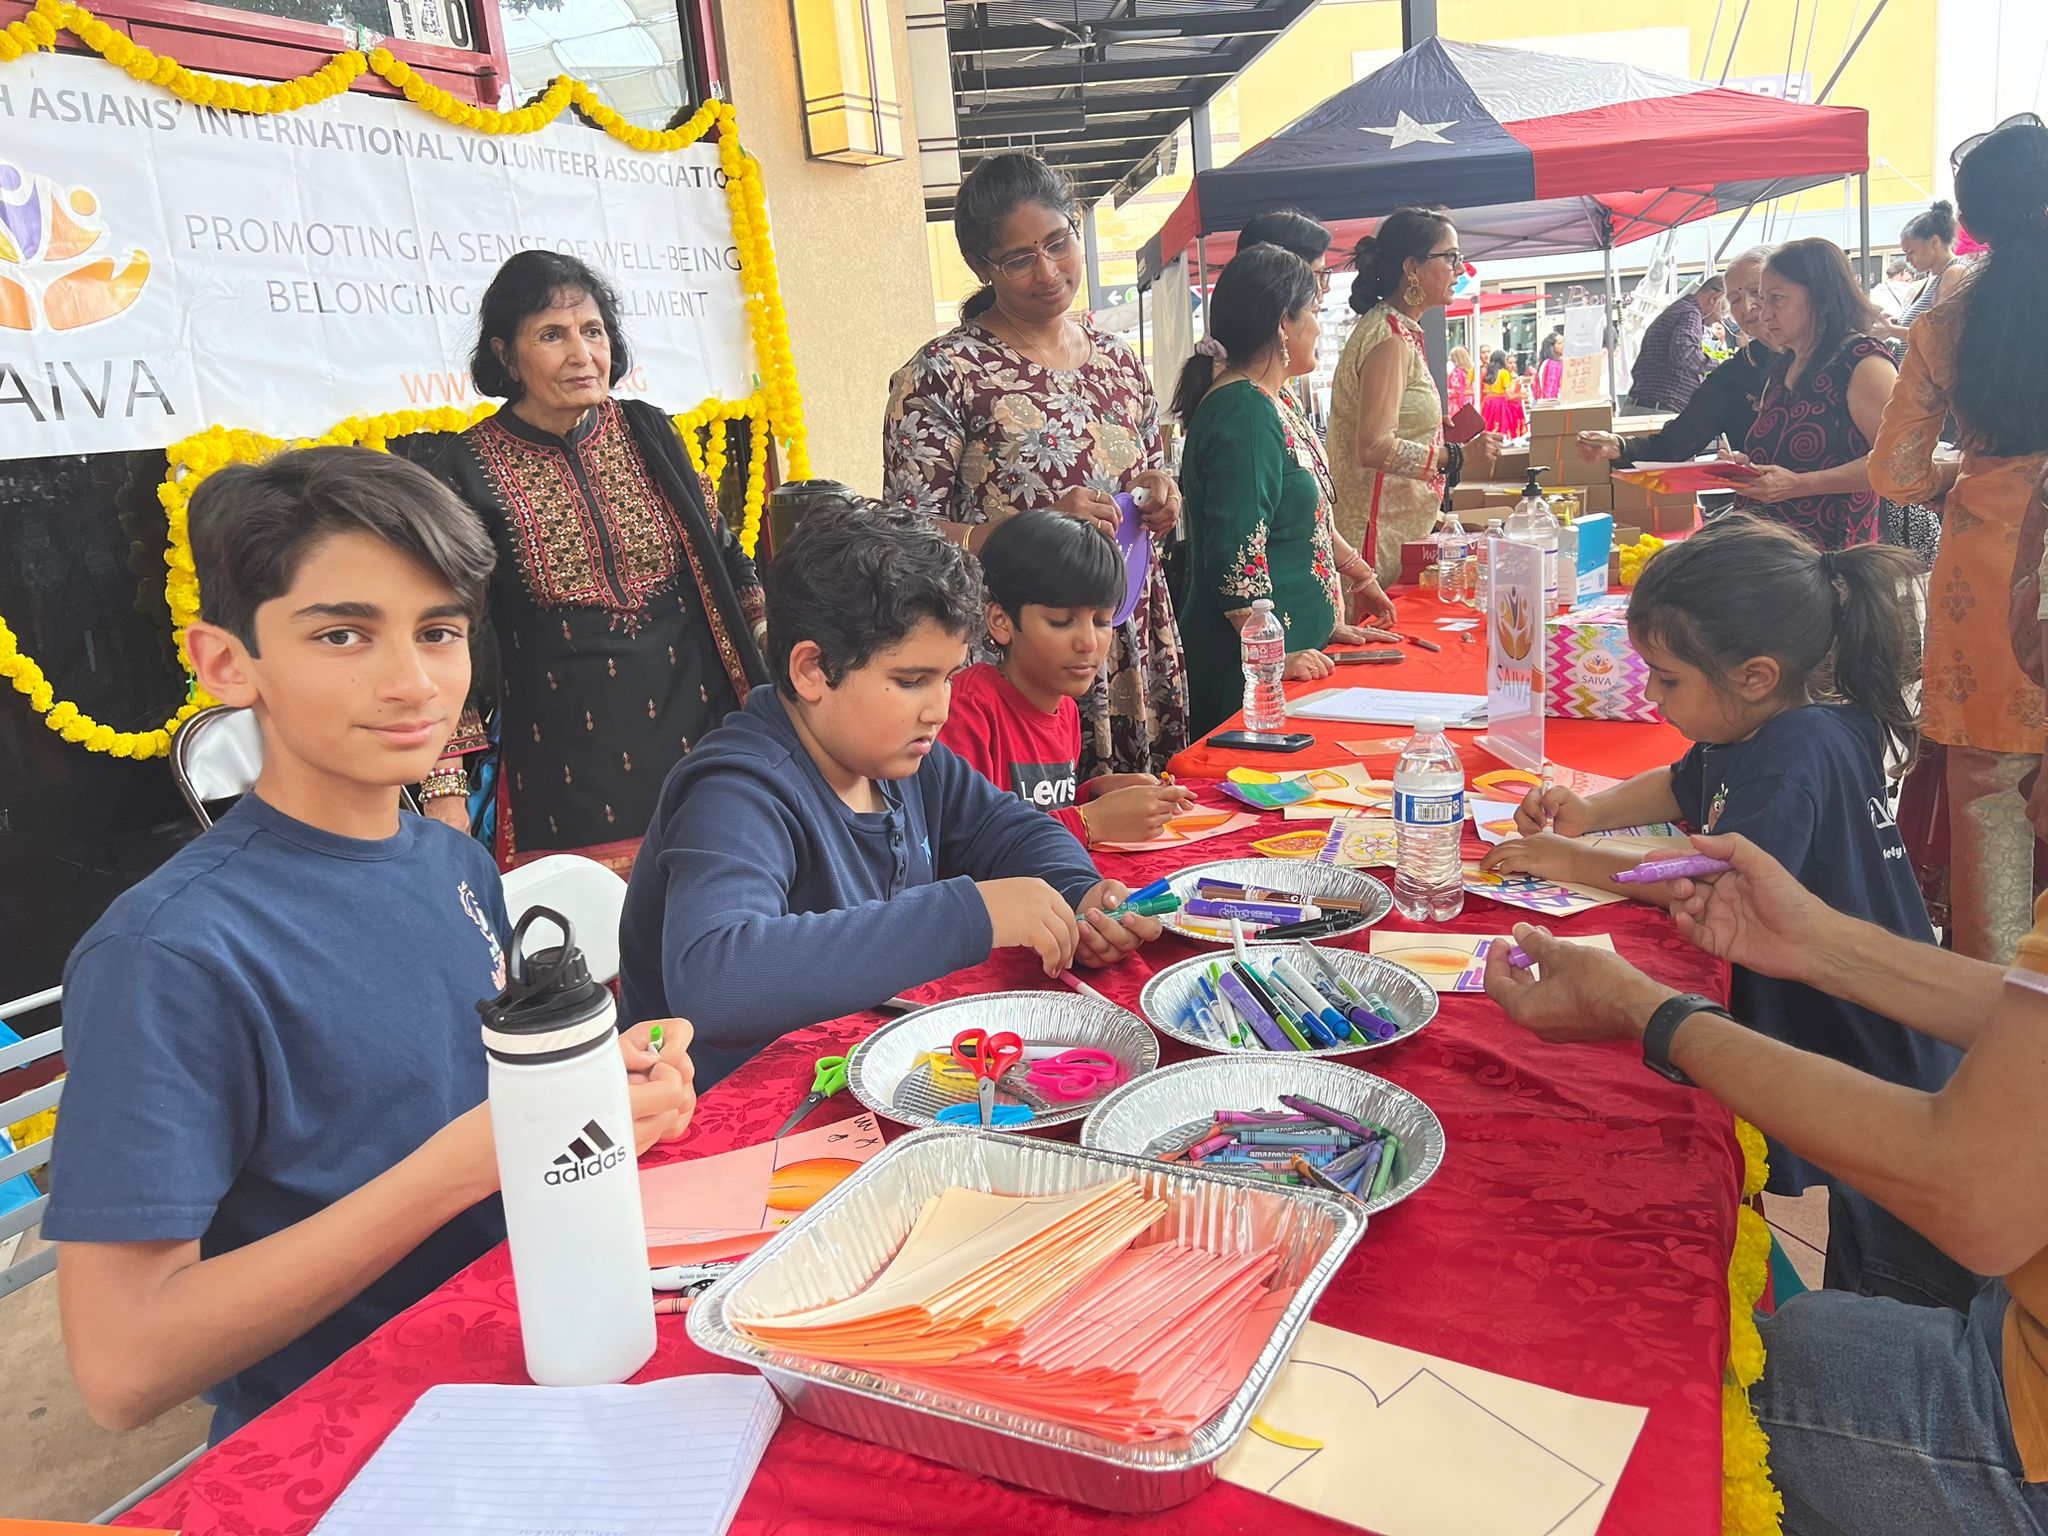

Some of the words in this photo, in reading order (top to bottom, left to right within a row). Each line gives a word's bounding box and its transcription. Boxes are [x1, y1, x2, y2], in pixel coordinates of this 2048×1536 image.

[194, 103, 454, 162] INTERNATIONAL
[461, 137, 599, 178] VOLUNTEER
[604, 156, 728, 190] ASSOCIATIO
[185, 214, 418, 261] PROMOTING
[428, 230, 451, 261] A
[594, 240, 743, 272] WELL-BEING
[266, 280, 471, 315] BELONGING
[620, 289, 709, 317] LLMENT
[0, 359, 176, 422] AIVA
[1496, 664, 1531, 704] SAIVA
[1581, 674, 1612, 686] SAIVA
[543, 1145, 627, 1186] adidas
